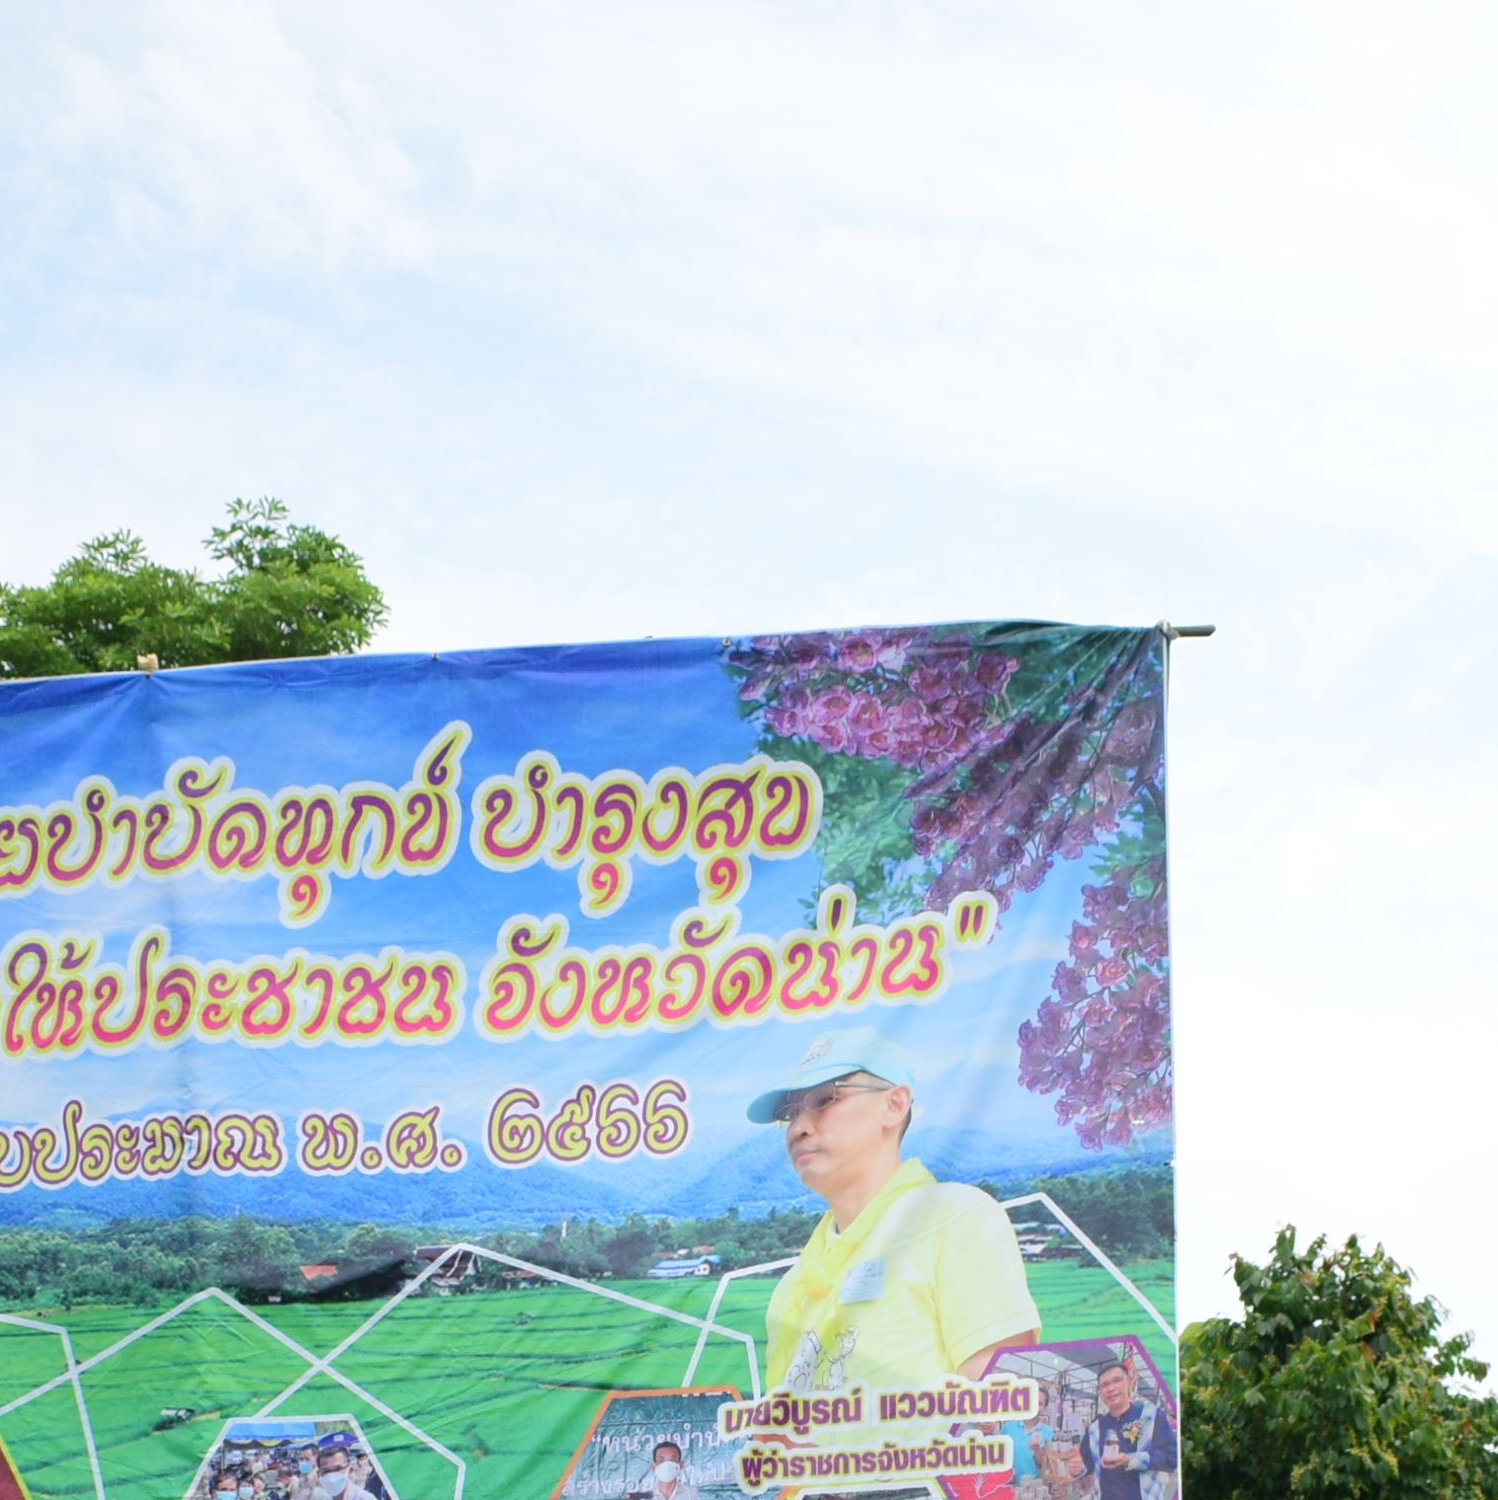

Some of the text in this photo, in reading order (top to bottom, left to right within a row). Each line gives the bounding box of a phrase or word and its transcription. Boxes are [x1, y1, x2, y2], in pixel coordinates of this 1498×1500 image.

[482, 757, 815, 908] บำรุงสุข
[300, 1105, 464, 1172] พ.ศ.
[488, 1080, 691, 1163] ๒๕๖๖
[880, 1380, 1032, 1421] แววบัณฑิต
[741, 1438, 1005, 1488] ผู้ว่าราชการจังหวัดน่าน
